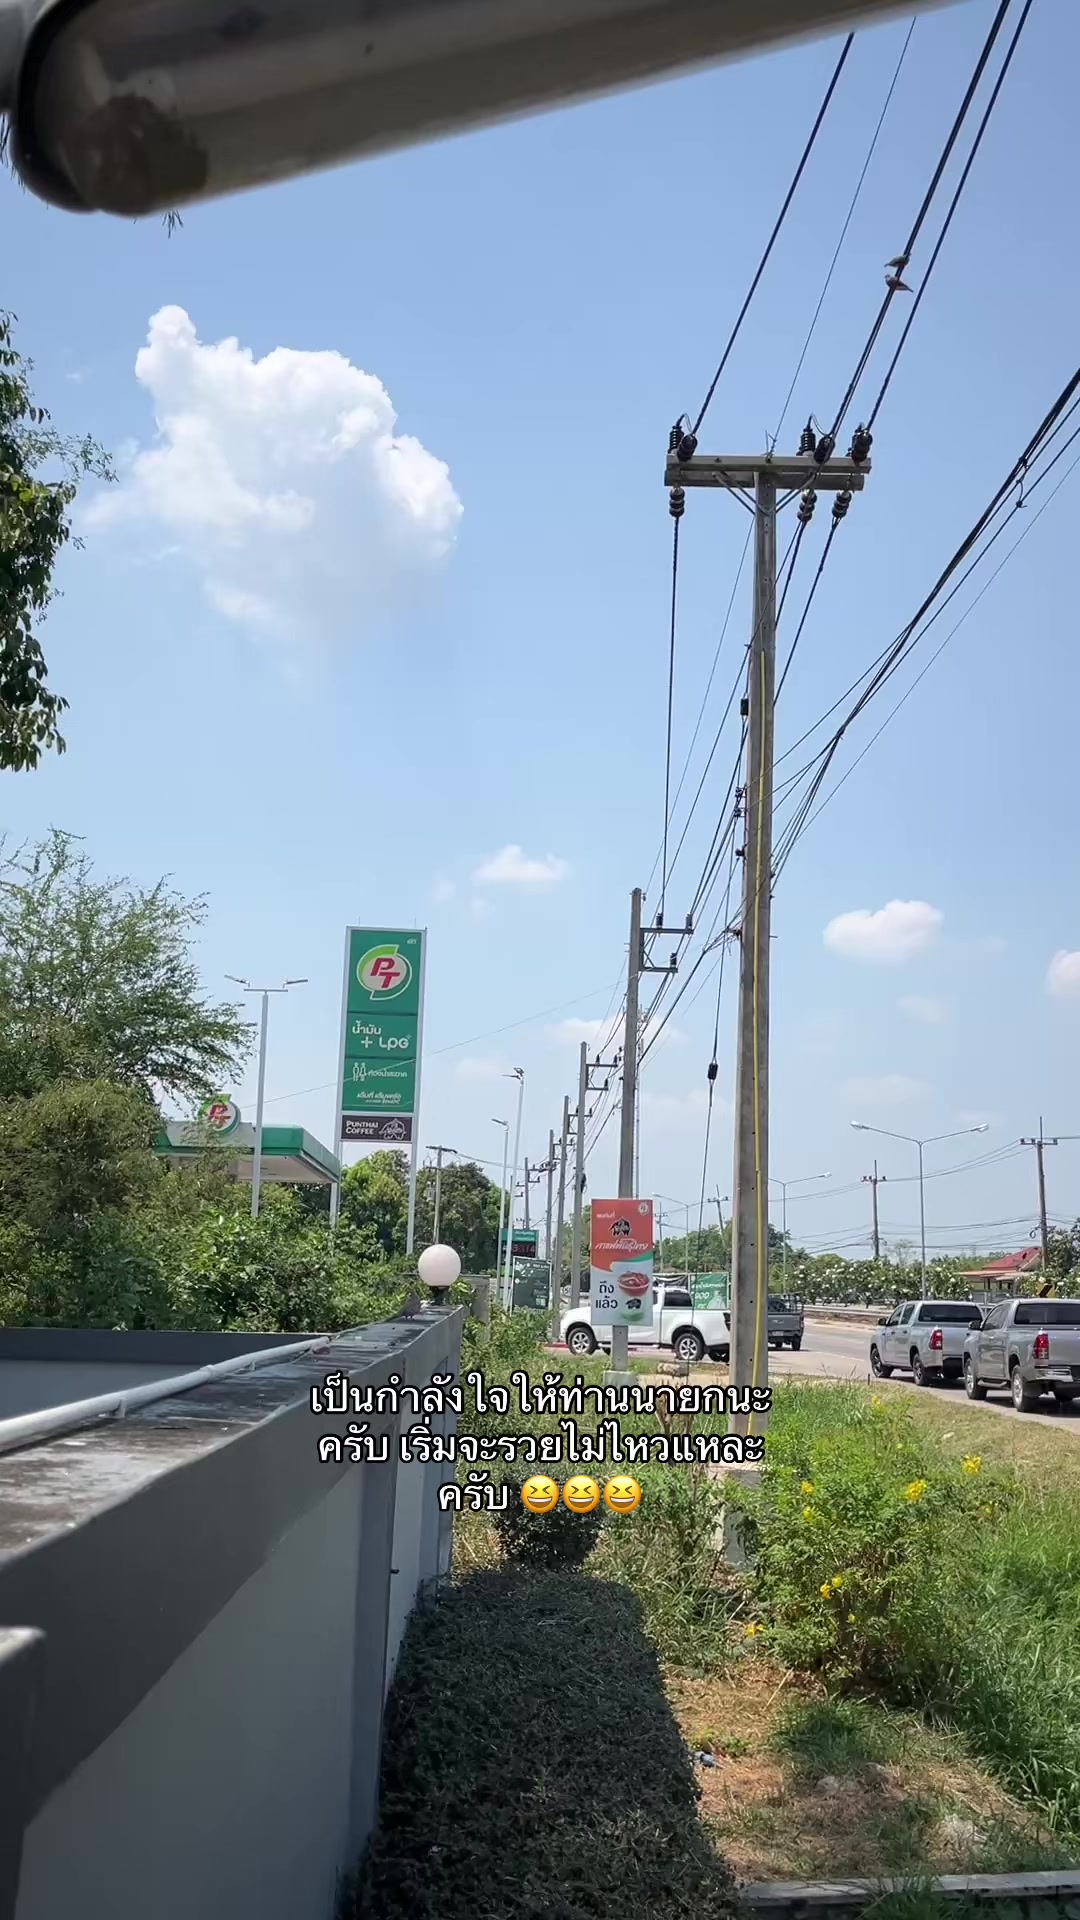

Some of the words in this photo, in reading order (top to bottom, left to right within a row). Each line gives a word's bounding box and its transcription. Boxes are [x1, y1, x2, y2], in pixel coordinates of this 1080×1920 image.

[370, 957, 400, 988] PT
[352, 1020, 381, 1034] น้ำมัน
[346, 1120, 379, 1128] PUNTHAI
[345, 1127, 374, 1135] COFFEE
[599, 1281, 615, 1294] ถึง
[595, 1296, 618, 1309] แล้ว
